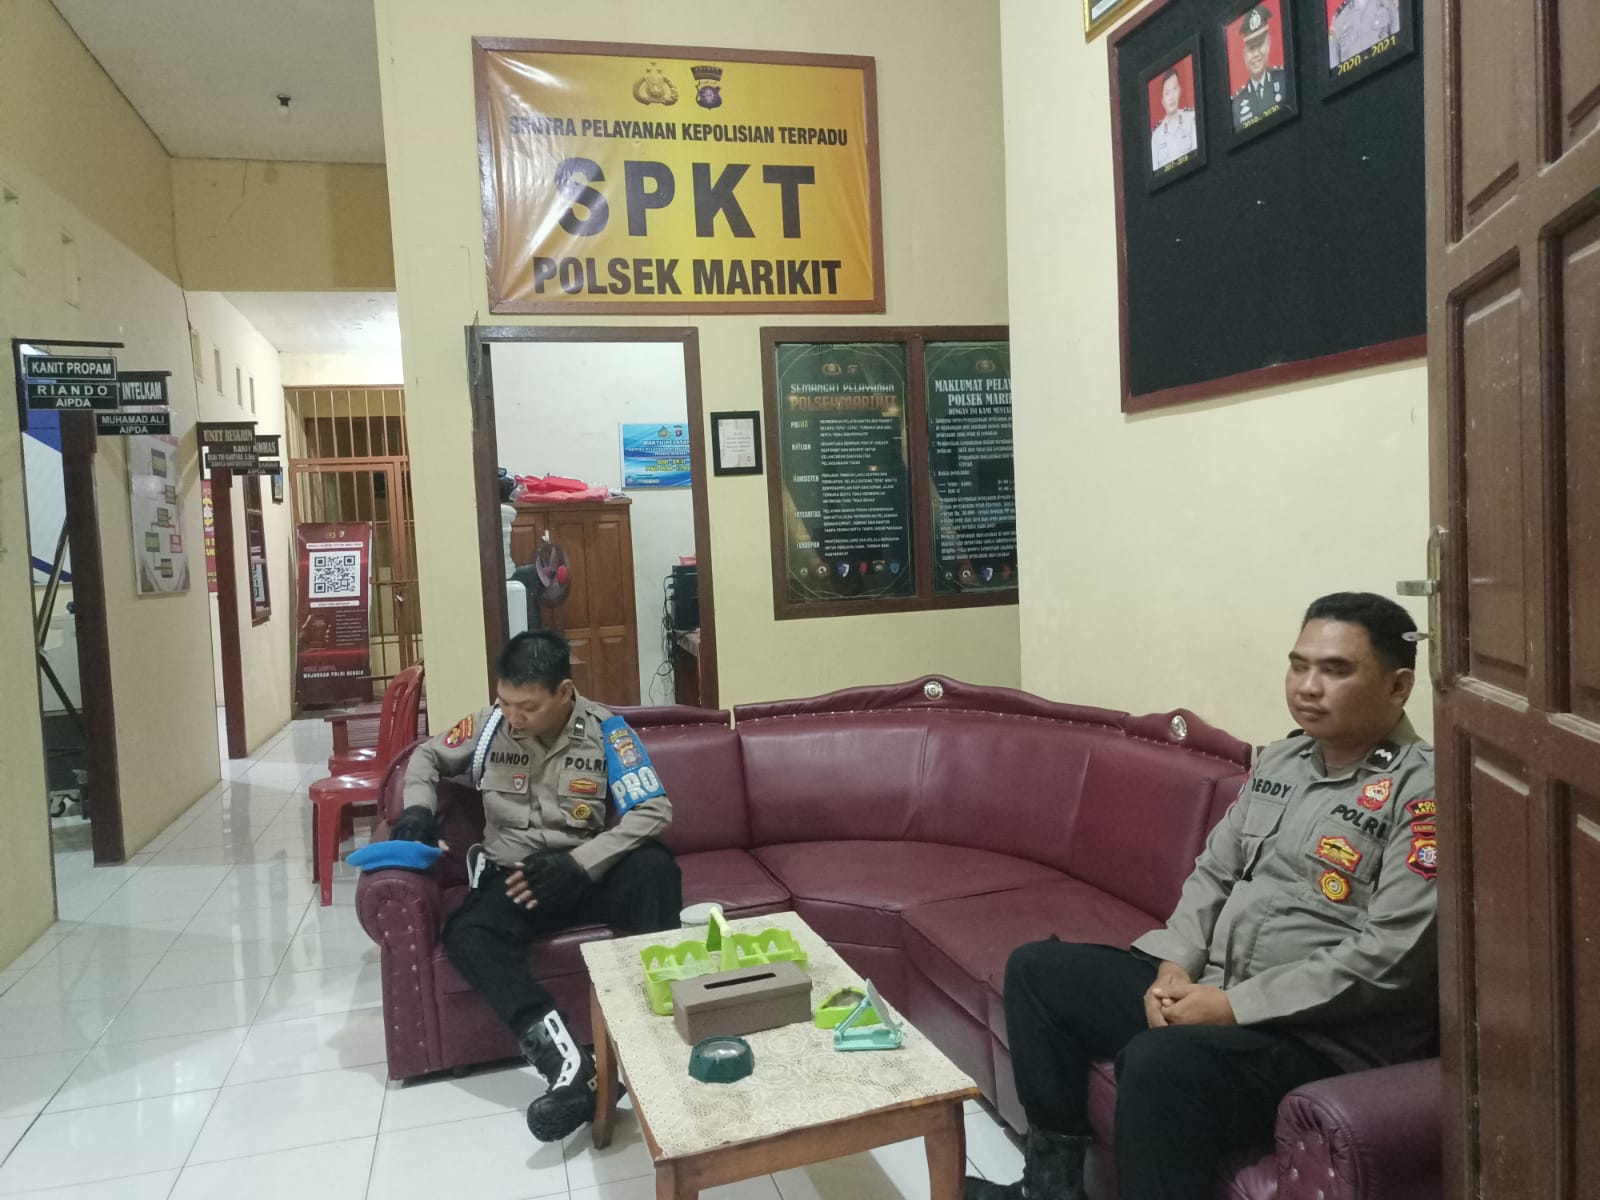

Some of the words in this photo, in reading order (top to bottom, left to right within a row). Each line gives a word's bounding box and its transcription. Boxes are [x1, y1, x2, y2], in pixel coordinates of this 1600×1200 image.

[1338, 54, 1361, 76] 2020
[1371, 35, 1396, 56] 2021
[582, 119, 677, 140] PELAYANAN
[682, 123, 775, 144] KEPOLISIAN
[779, 127, 848, 146] TERPADU
[554, 157, 816, 239] SPKT
[533, 256, 682, 296] POLSEK
[693, 259, 842, 296] MARIKIT
[32, 361, 64, 373] KANIT
[67, 362, 111, 375] PROPAM
[37, 385, 108, 396] RIANDO
[122, 382, 162, 400] INTELKAM
[935, 379, 983, 392] MAKLUMAT
[56, 398, 91, 407] AIPDA
[948, 393, 983, 406] POLSEK
[101, 415, 148, 424] MUHAMAD
[150, 415, 164, 423] ALI
[120, 426, 149, 434] AIPDA
[490, 751, 529, 766] RIANDO
[564, 757, 607, 772] POLRI
[1331, 803, 1387, 838] POLRI
